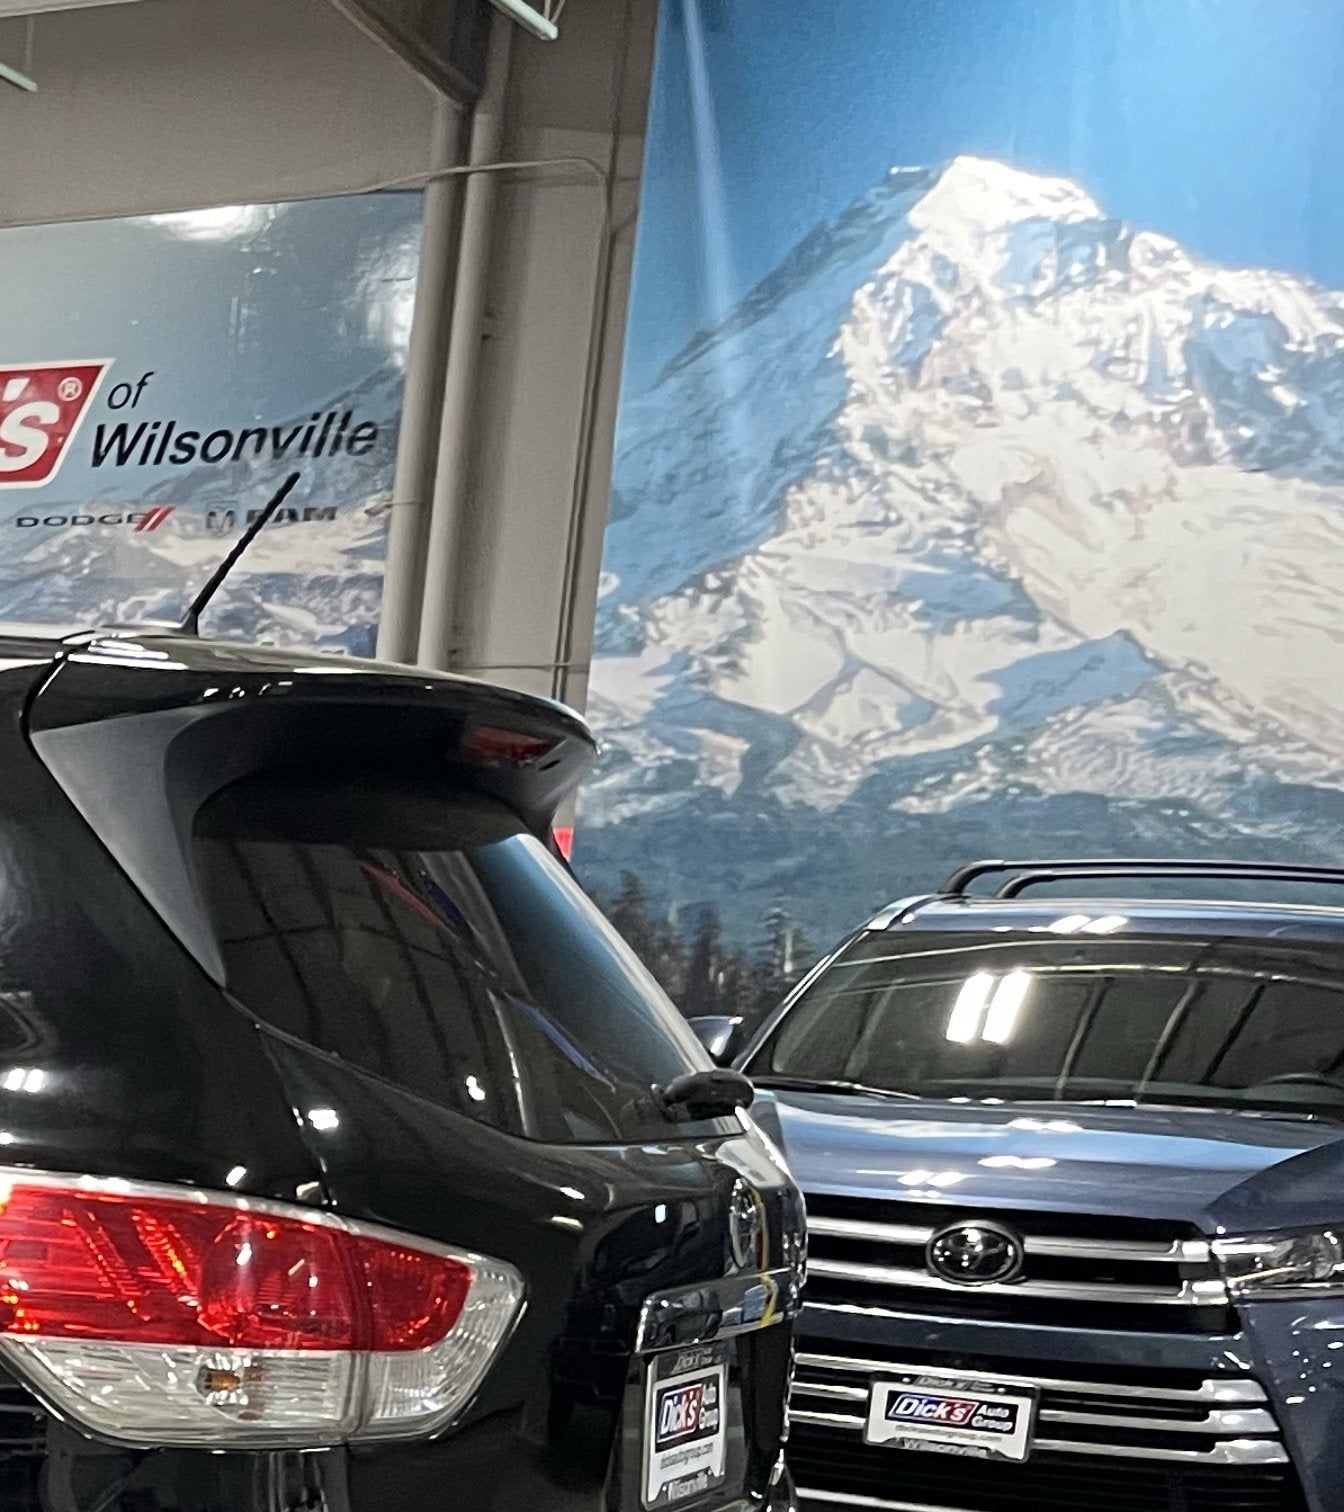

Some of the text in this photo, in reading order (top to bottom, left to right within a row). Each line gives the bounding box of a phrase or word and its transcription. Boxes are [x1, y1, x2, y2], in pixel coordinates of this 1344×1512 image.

[107, 371, 154, 409] of
[91, 409, 379, 468] Wilsonville
[16, 512, 147, 528] DODGE
[661, 1390, 698, 1435] Dick's
[896, 1398, 1010, 1421] Dick's Auto
[971, 1416, 1013, 1431] Group
